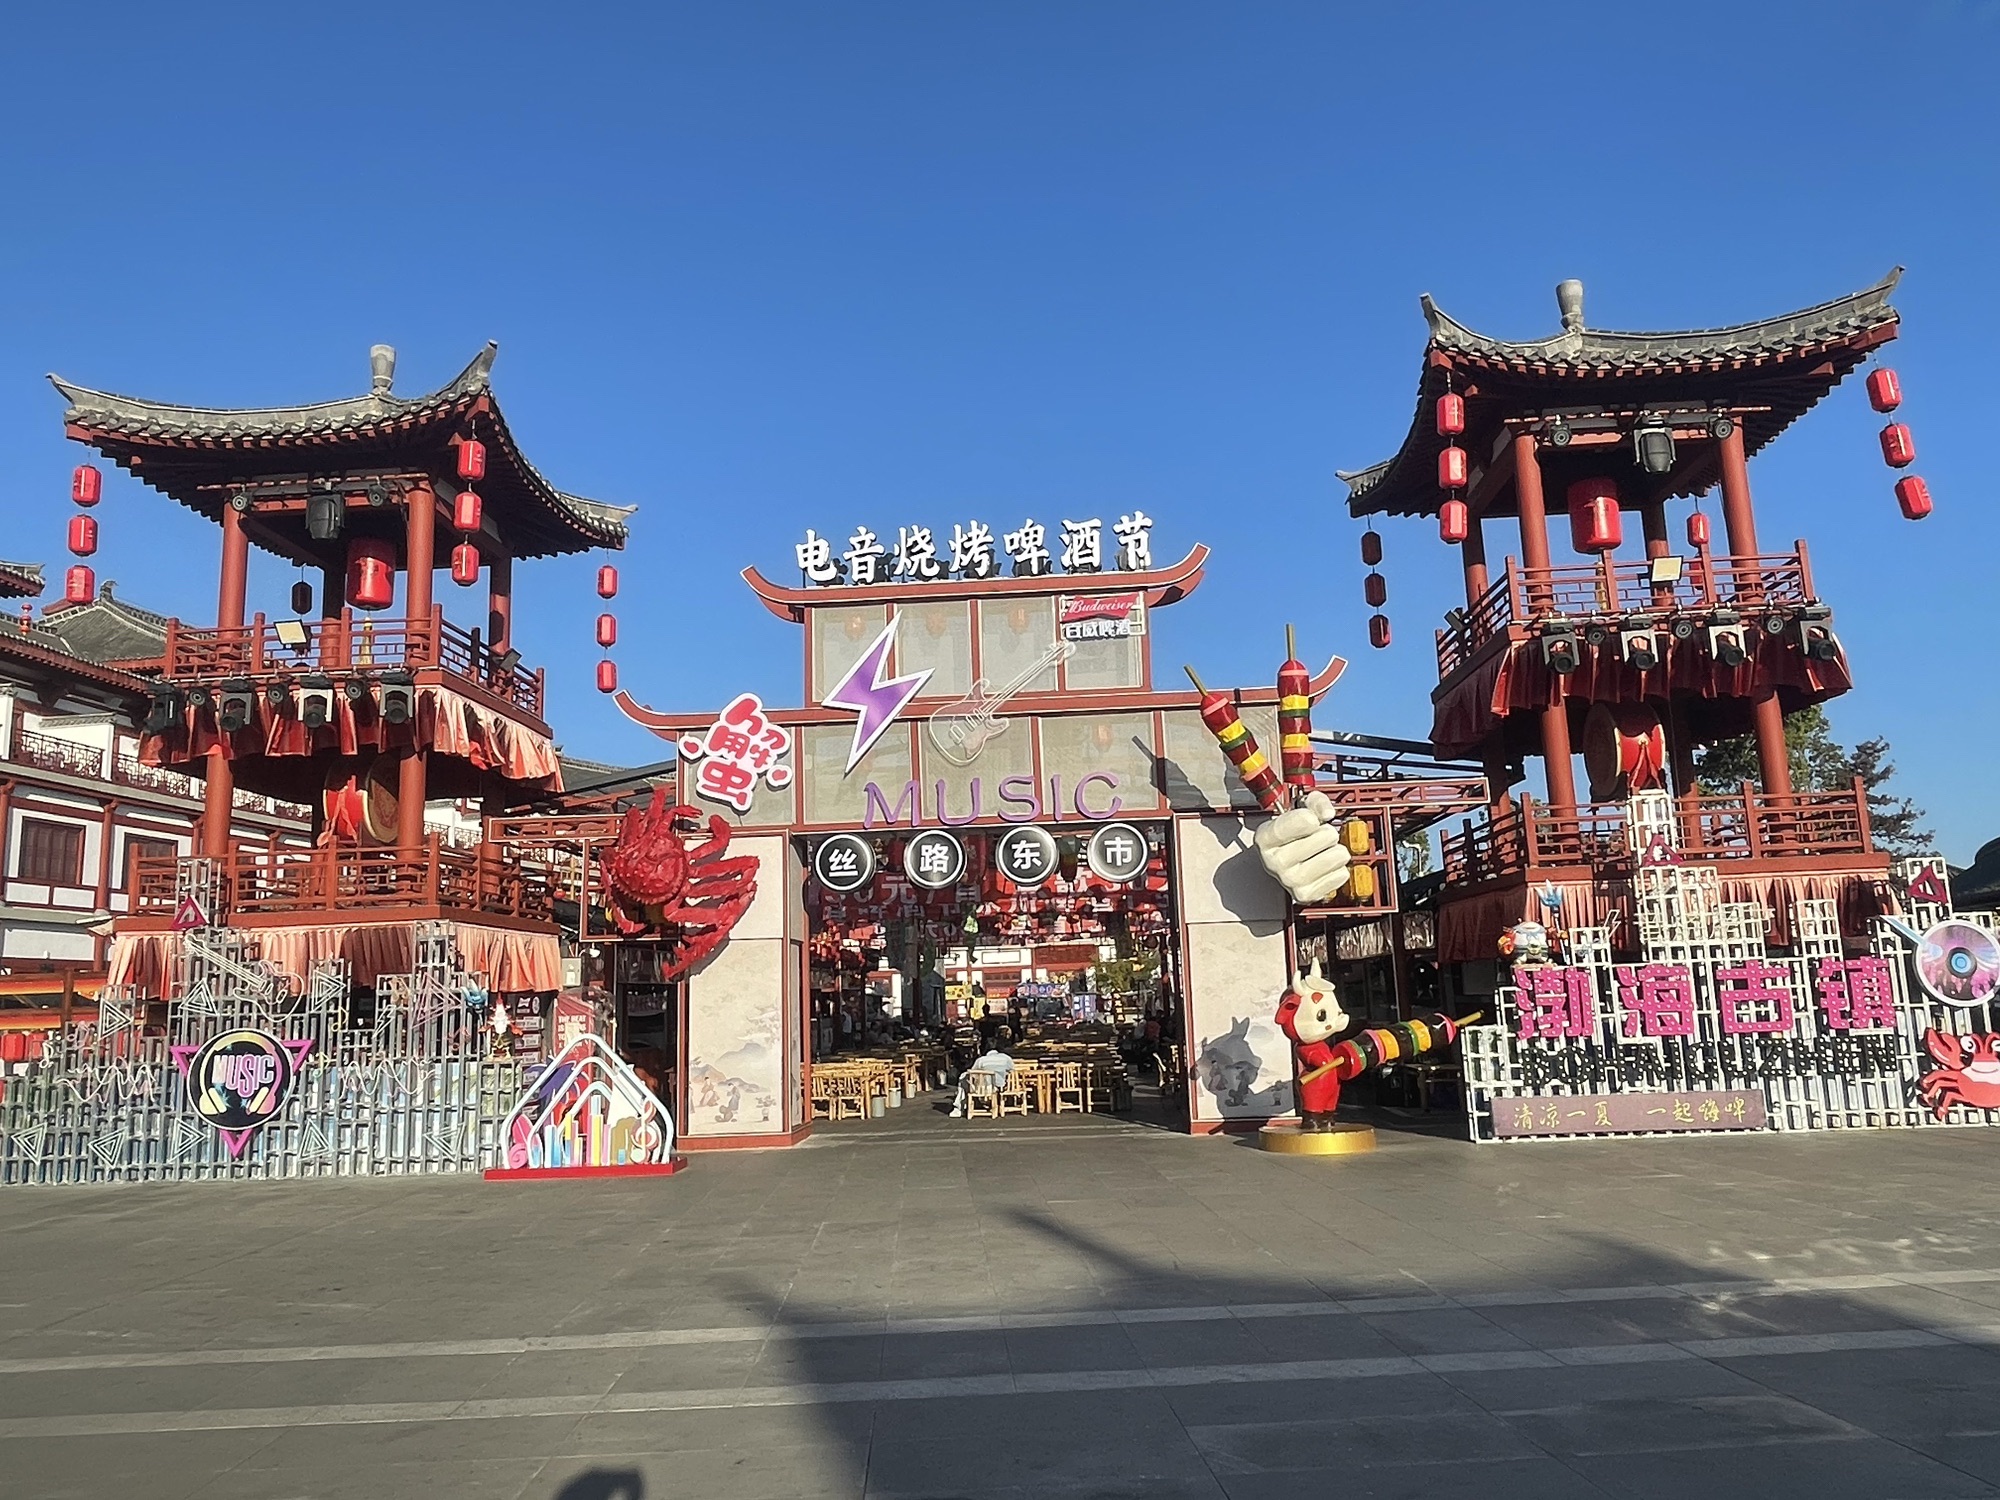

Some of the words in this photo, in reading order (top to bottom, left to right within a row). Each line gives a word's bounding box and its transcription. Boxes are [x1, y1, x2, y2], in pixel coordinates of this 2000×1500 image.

[795, 510, 1154, 584] 电音烧烤啤酒节
[1069, 599, 1134, 613] Budweiser
[1066, 619, 1131, 638] 百威啤酒
[863, 772, 1123, 829] MUSIC
[828, 836, 1134, 878] 丝路东市
[1514, 956, 1897, 1040] 渤海古镇
[212, 1053, 275, 1098] MUSIC
[1513, 1099, 1613, 1130] 清凉一夏
